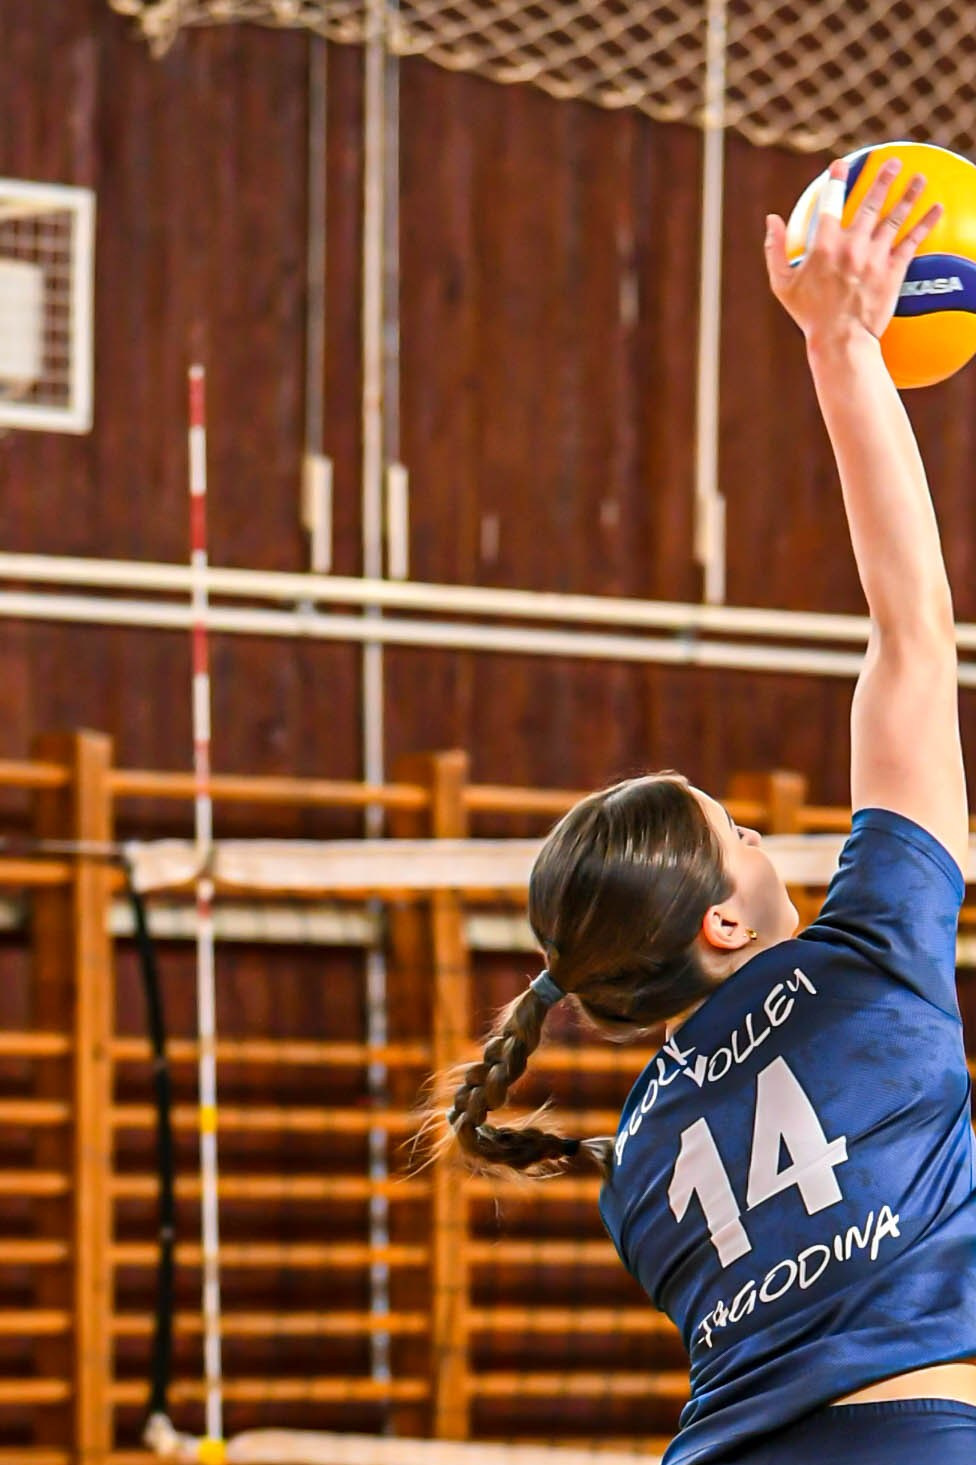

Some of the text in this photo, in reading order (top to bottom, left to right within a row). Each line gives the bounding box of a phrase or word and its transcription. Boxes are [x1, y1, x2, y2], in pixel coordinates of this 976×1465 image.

[682, 967, 817, 1088] VOLLEY
[667, 1055, 848, 1269] 14
[697, 1205, 901, 1348] JAGODINA
